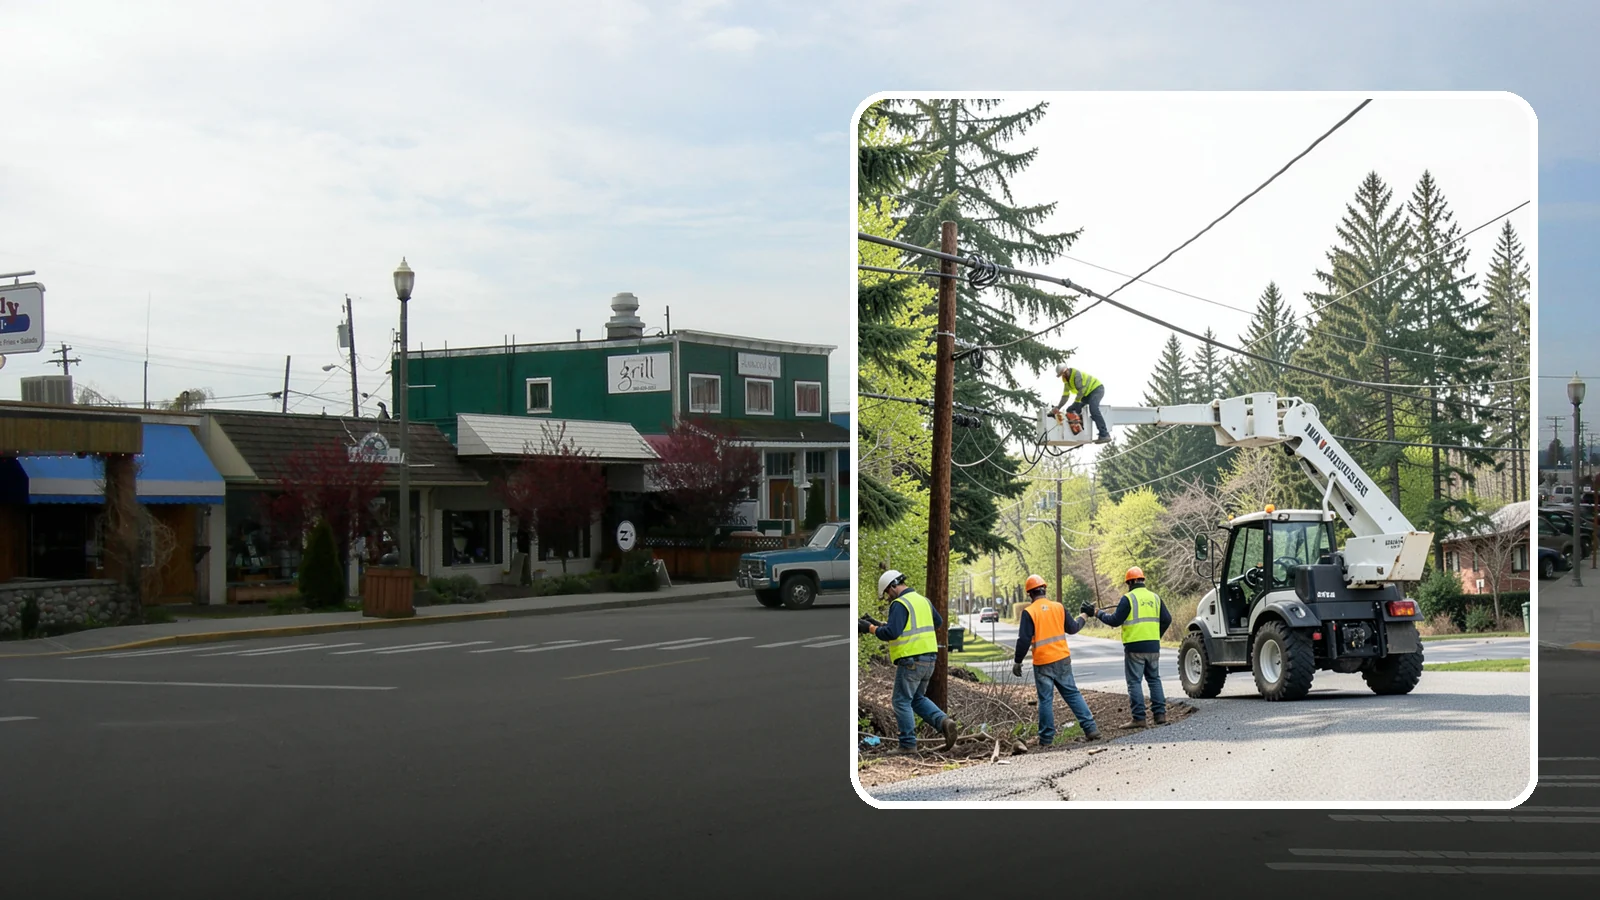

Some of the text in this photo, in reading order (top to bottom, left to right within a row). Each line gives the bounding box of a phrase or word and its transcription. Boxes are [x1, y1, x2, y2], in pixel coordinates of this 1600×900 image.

[3, 337, 38, 347] Fries Salads
[618, 355, 655, 391] grill
